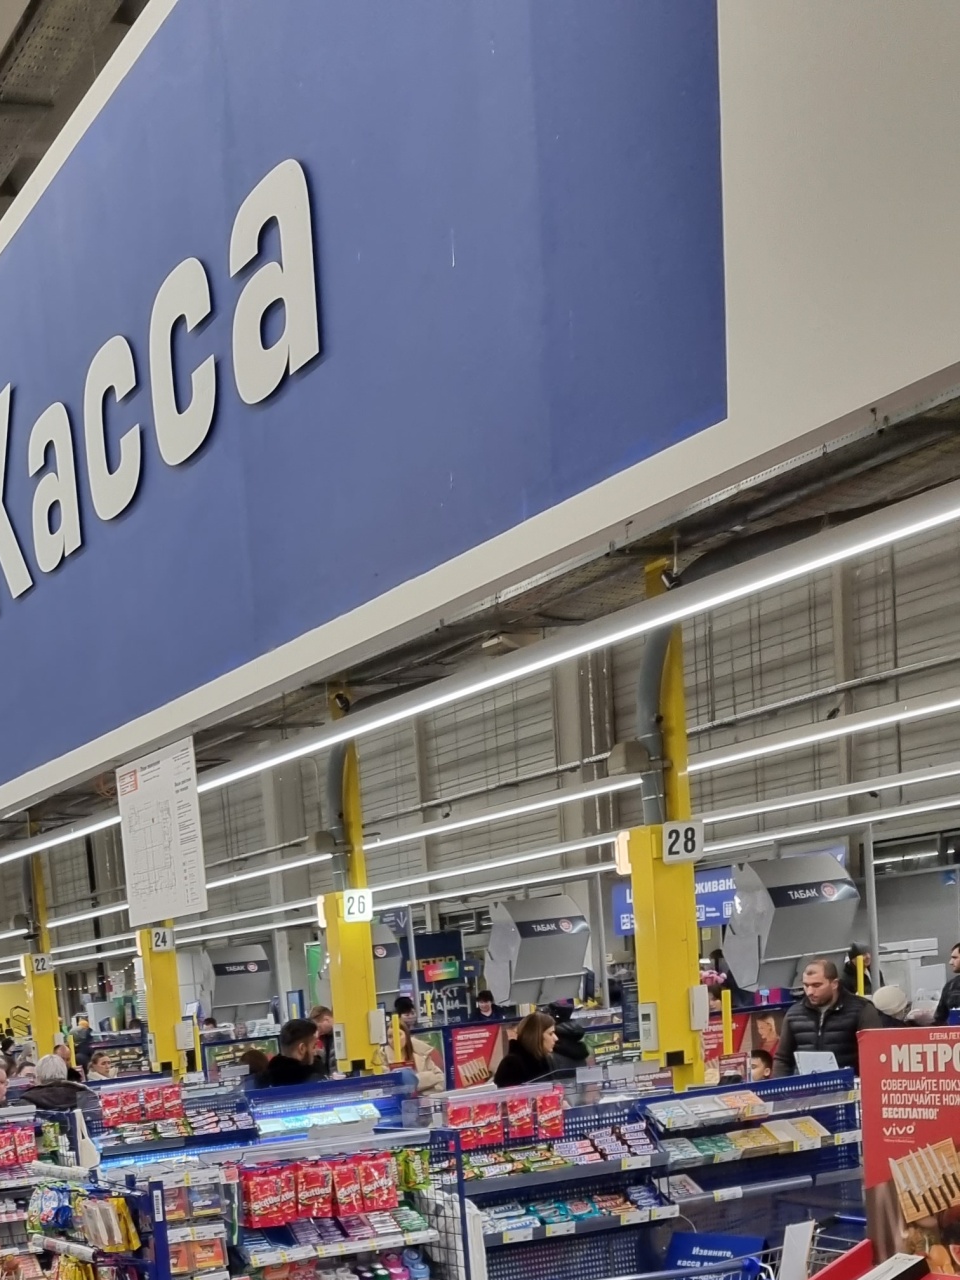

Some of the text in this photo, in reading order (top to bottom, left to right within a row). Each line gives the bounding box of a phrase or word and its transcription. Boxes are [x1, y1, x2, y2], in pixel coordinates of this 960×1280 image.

[667, 827, 696, 856] 28
[788, 888, 819, 900] ТАБАК
[347, 895, 366, 915] 26
[531, 923, 557, 933] ТАБАК
[154, 931, 167, 947] 24
[34, 957, 46, 971] 22
[929, 1032, 948, 1041] ЕЛЕНА
[594, 1045, 620, 1054] METRO
[881, 1076, 936, 1092] СОВЕРШАЙТЕ
[881, 1093, 888, 1105] И
[889, 1091, 941, 1106] ПОЛУЧАЙТЕ
[883, 1123, 915, 1137] vivo
[692, 1246, 734, 1259] Извините,
